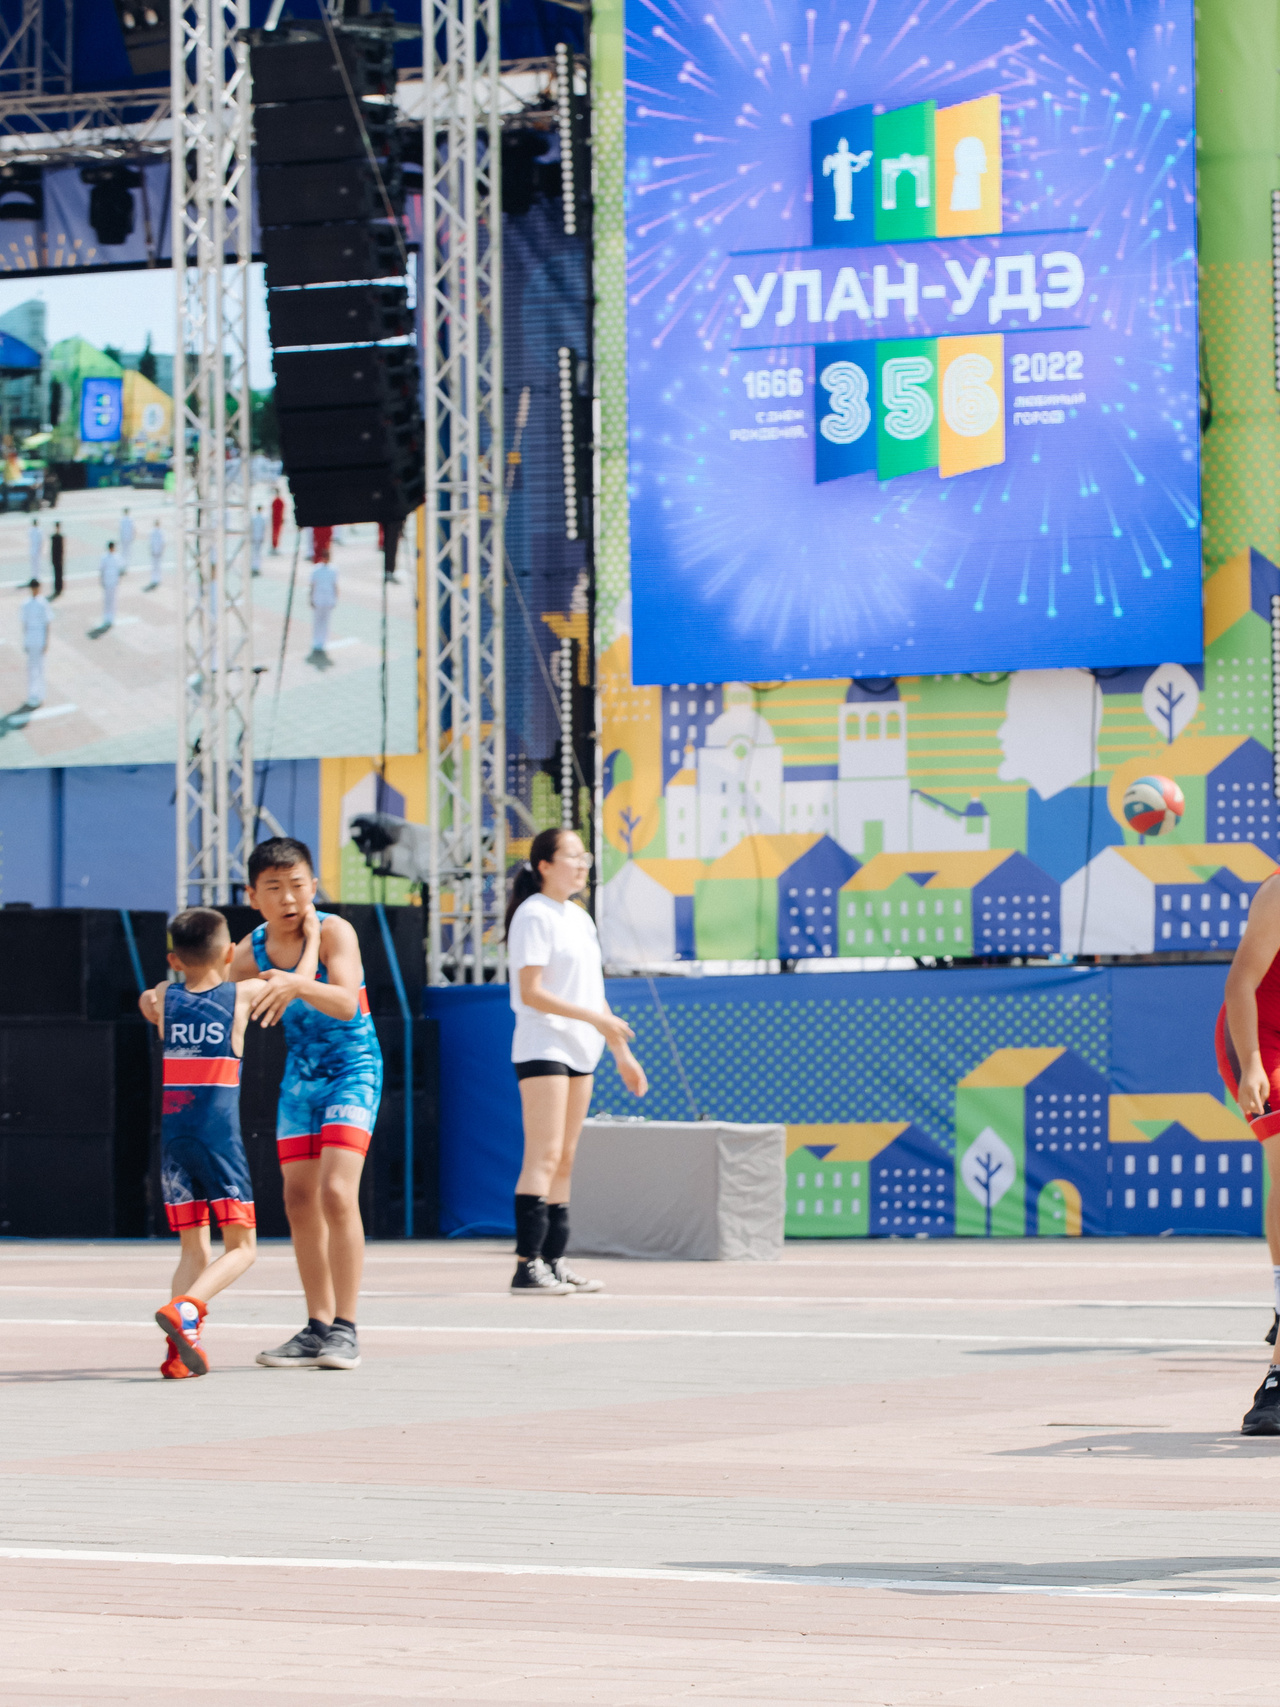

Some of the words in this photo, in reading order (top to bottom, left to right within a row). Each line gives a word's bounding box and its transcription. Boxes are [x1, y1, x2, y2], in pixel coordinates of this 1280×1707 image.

[733, 251, 1085, 329] УЛАН-УДЭ
[742, 367, 804, 400] 1666
[1012, 350, 1084, 384] 2022
[819, 353, 1001, 445] 356
[170, 1021, 225, 1045] RUS
